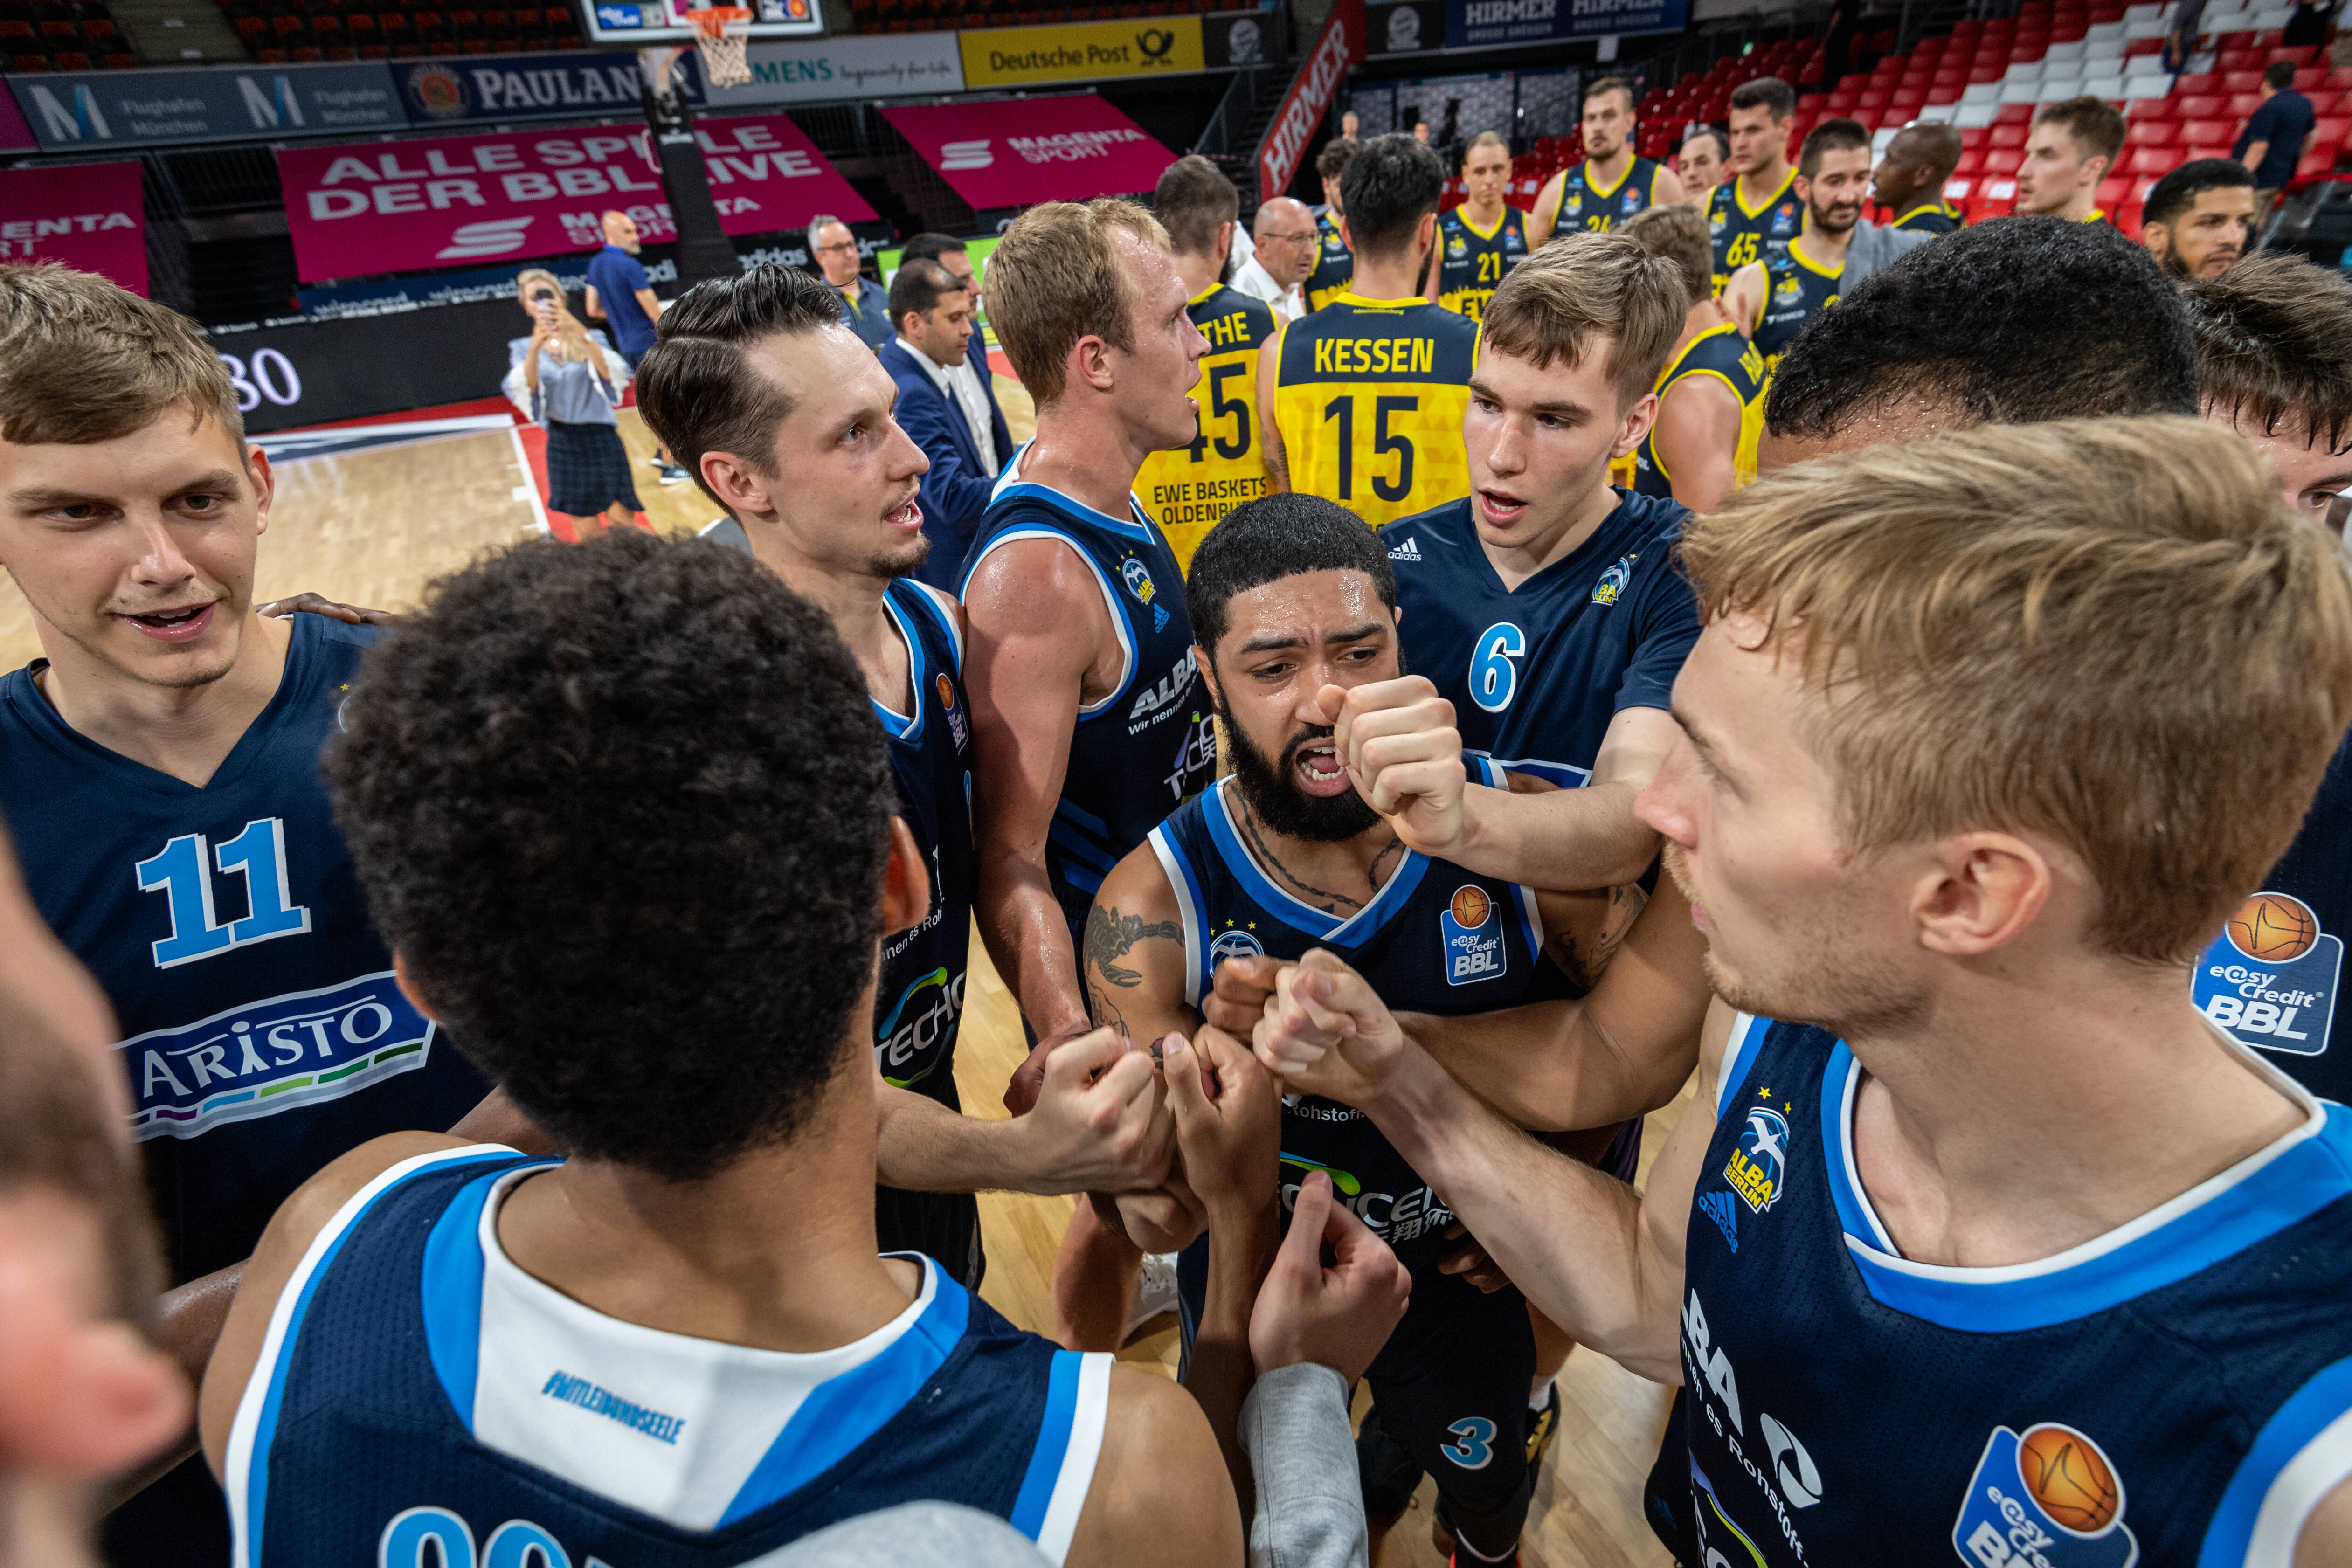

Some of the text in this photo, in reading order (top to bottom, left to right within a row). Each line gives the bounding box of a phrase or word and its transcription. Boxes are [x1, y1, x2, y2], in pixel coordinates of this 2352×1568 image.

[1465, 0, 1556, 26] HIRMER
[753, 58, 833, 83] MENS
[990, 44, 1130, 71] Deutsche Post
[122, 98, 206, 117] Flughafen
[1264, 19, 1349, 193] HIRMER
[321, 143, 526, 186] ALLE
[535, 125, 782, 166] SPILE
[1007, 129, 1146, 151] MAGENTA
[1020, 143, 1109, 164] SPORT
[307, 150, 822, 221] DER BBL IVE
[1, 212, 137, 239] ENTA
[1477, 251, 1501, 282] 21
[1726, 232, 1762, 267] 65
[1197, 311, 1251, 345] THE
[1315, 338, 1435, 374] KESSEN
[1324, 395, 1418, 502] 15
[1154, 476, 1266, 504] EWE BASKETS
[1162, 501, 1236, 525] OLDENB
[1387, 551, 1422, 561] adidas
[1598, 584, 1616, 598] BA
[1129, 644, 1197, 719] ALBA
[1468, 622, 1525, 712] 6
[1128, 720, 1149, 735] Wir
[1152, 695, 1185, 725] nennen
[135, 817, 312, 969] 11
[1454, 951, 1498, 977] BBL
[2206, 994, 2308, 1041] BBL
[1725, 1165, 1763, 1208] BERLIN
[1728, 1148, 1775, 1204] ALBA
[1698, 1196, 1738, 1254] adidas
[1681, 1288, 1743, 1437] BA
[1706, 1403, 1722, 1437] es
[1440, 1416, 1498, 1470] 3
